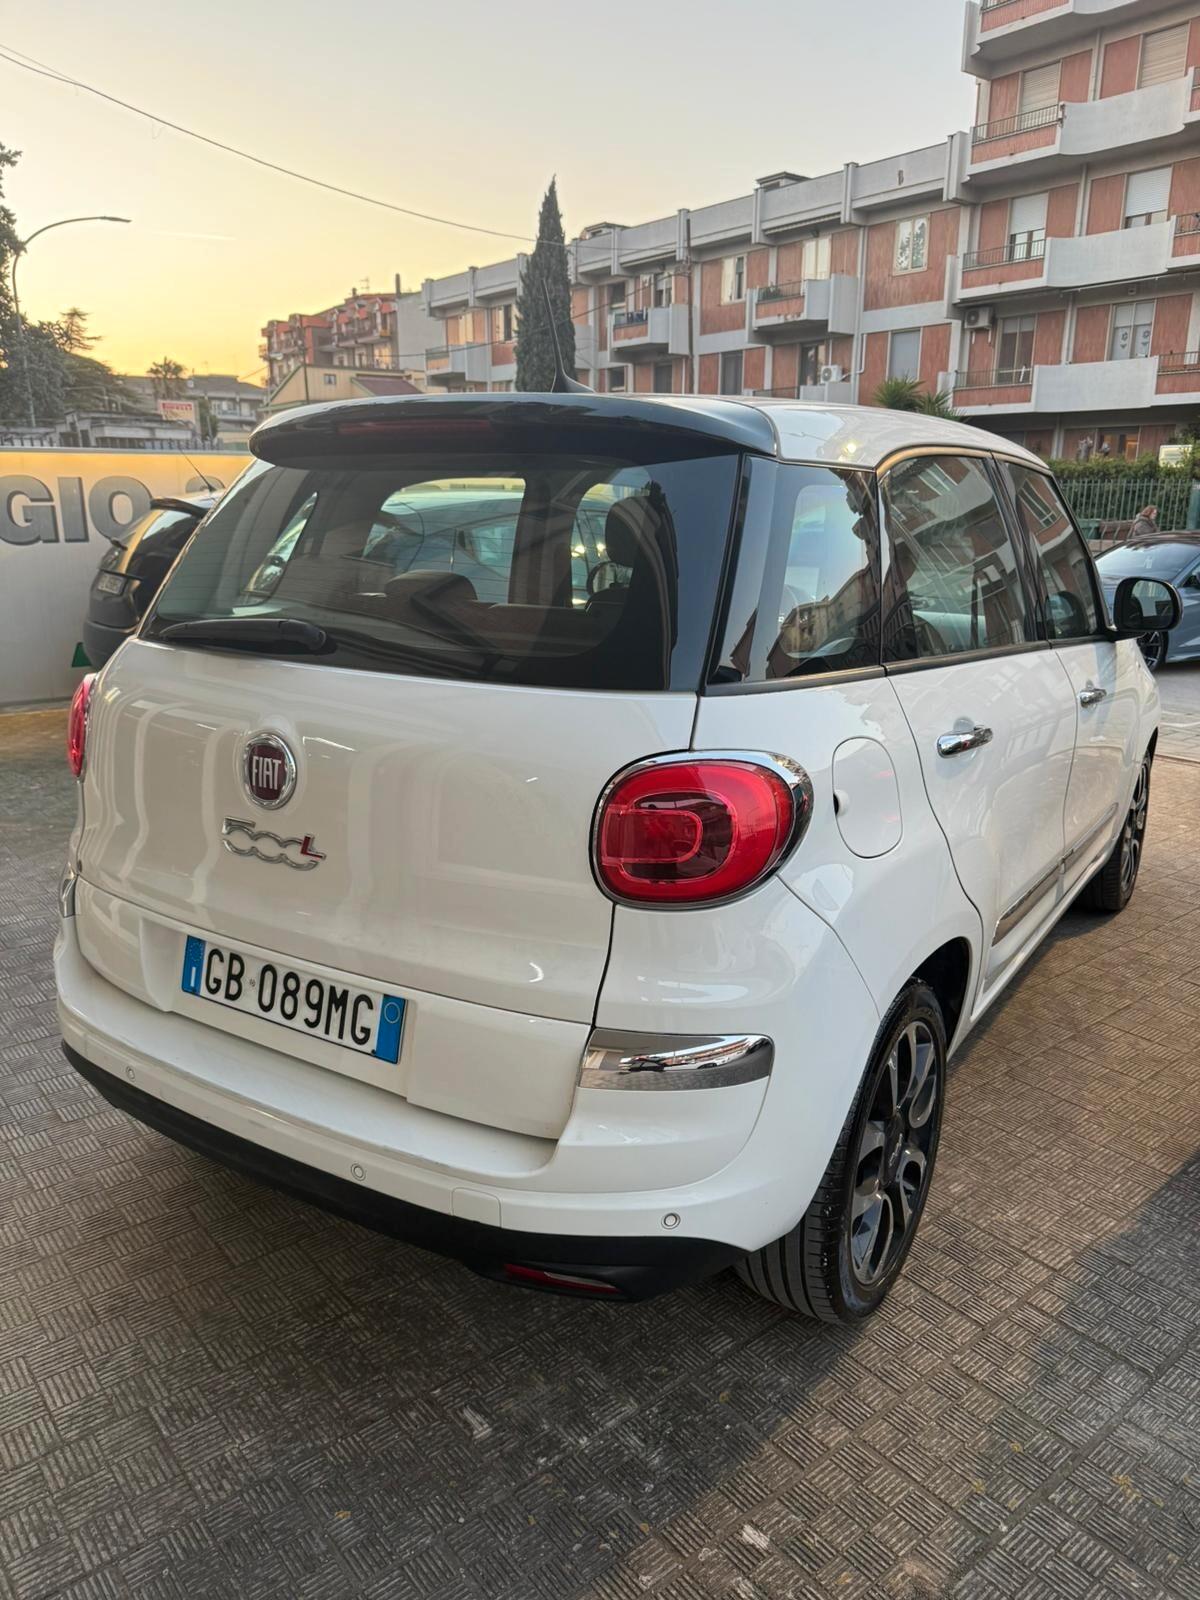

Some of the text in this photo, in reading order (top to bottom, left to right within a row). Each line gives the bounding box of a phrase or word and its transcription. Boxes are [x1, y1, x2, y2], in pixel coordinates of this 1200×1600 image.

[252, 755, 281, 790] FIAT
[205, 948, 374, 1045] GB 089MG
